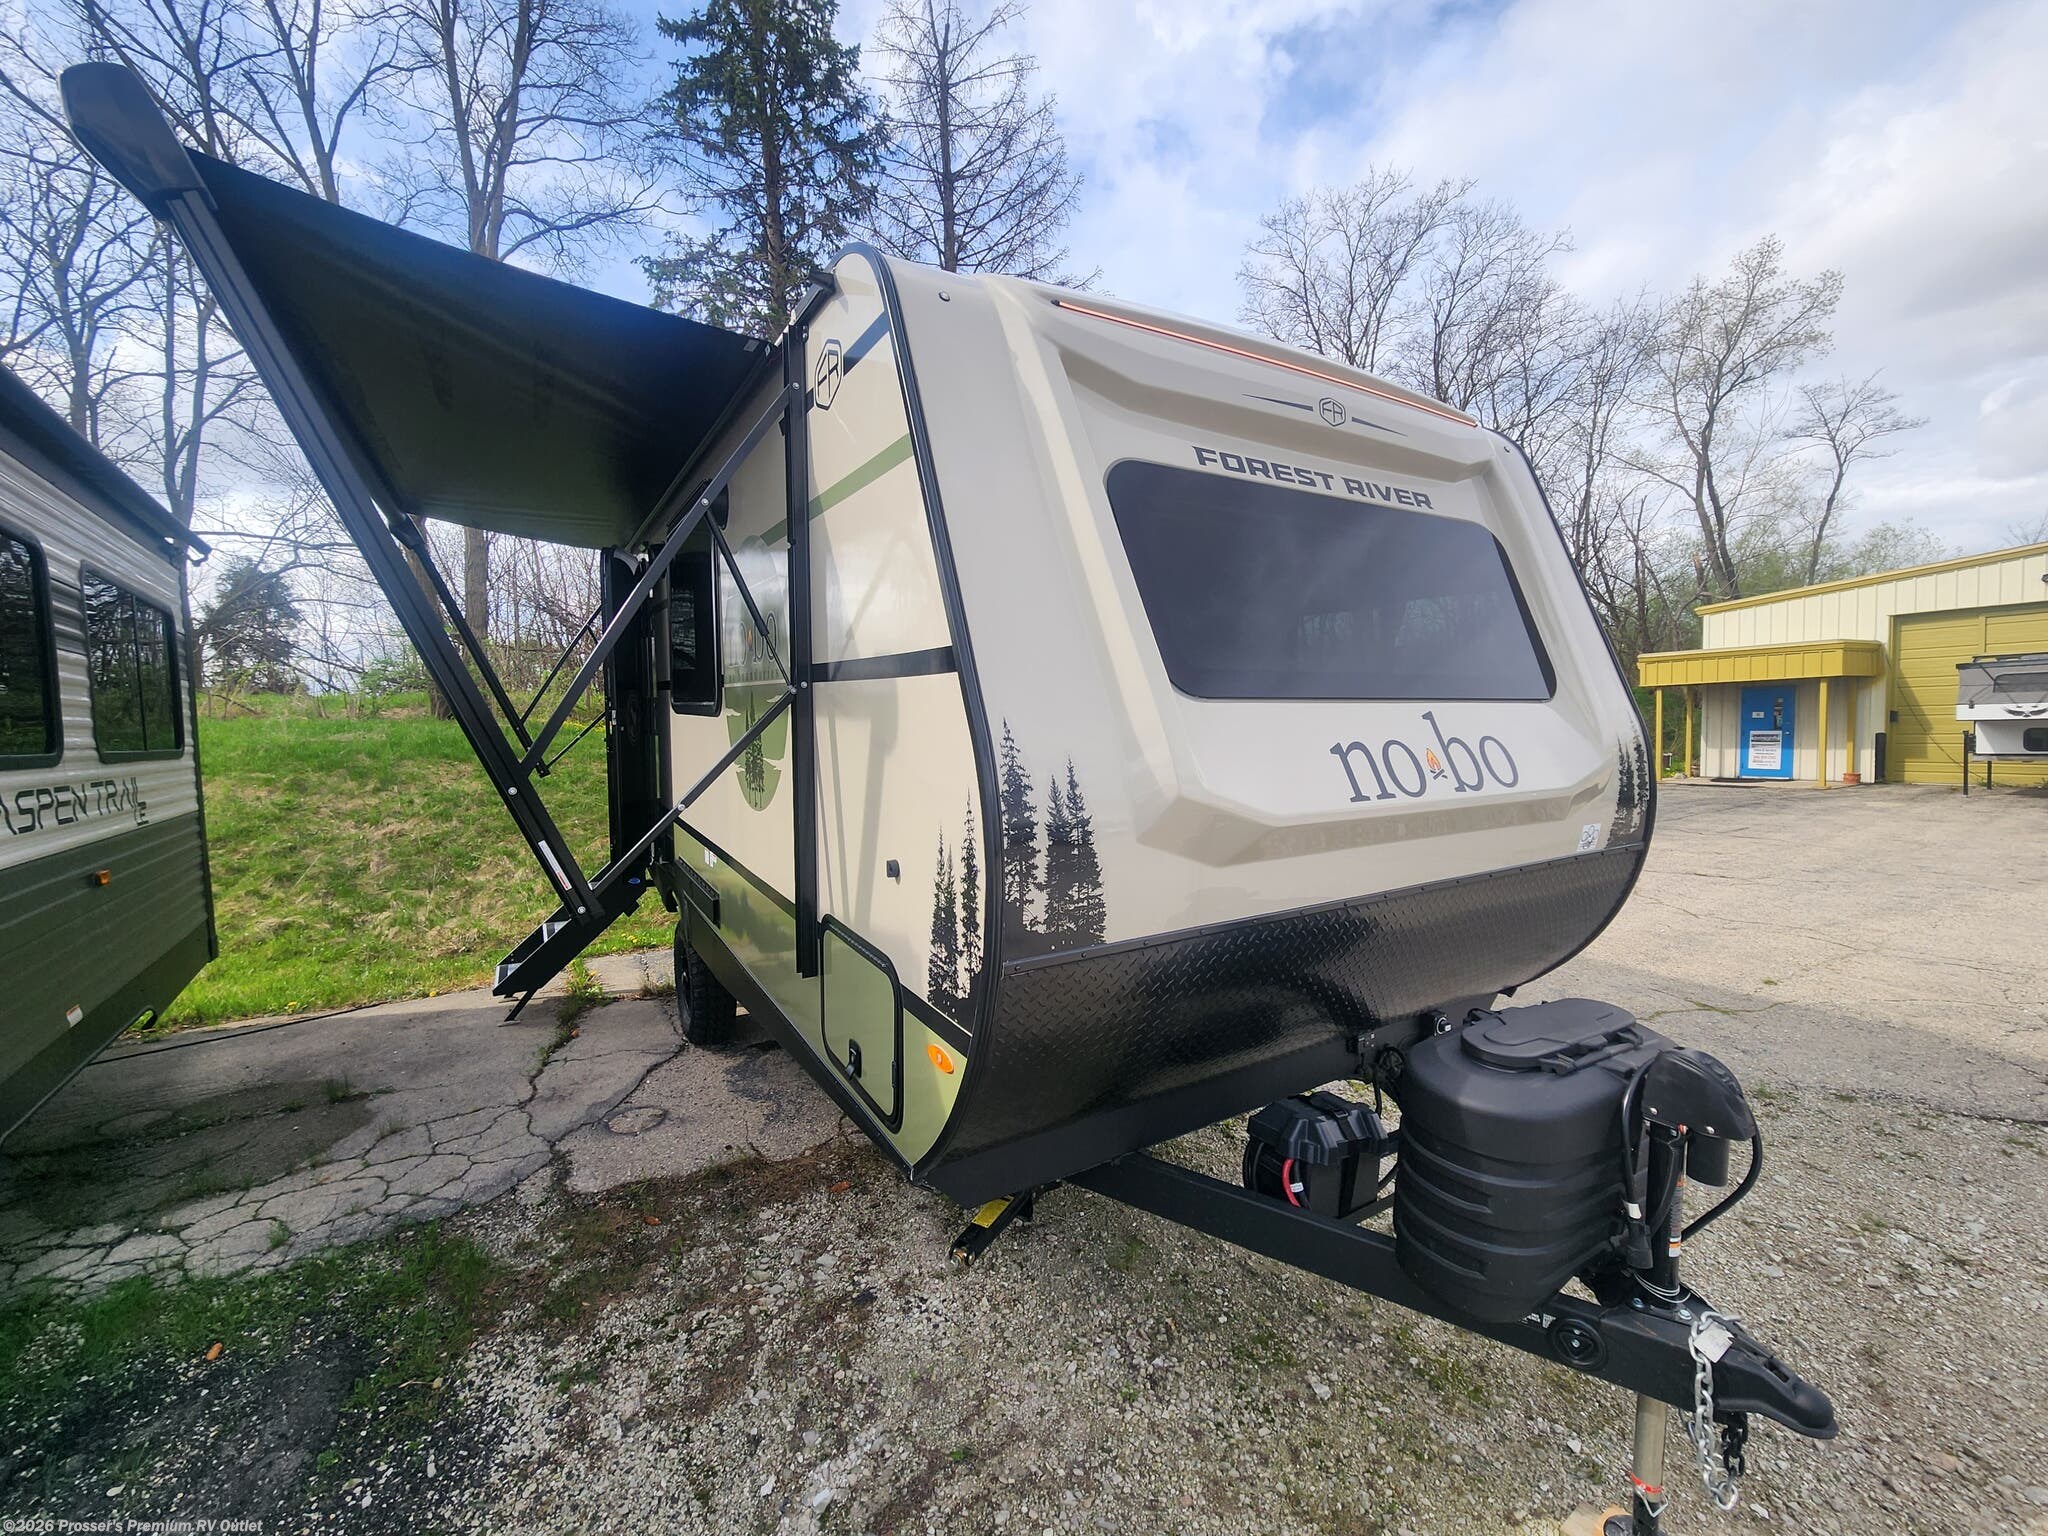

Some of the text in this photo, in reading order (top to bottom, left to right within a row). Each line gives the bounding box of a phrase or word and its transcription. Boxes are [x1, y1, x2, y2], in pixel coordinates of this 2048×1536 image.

[1192, 446, 1434, 510] FOREST RIVER
[90, 776, 147, 816] TRAIL
